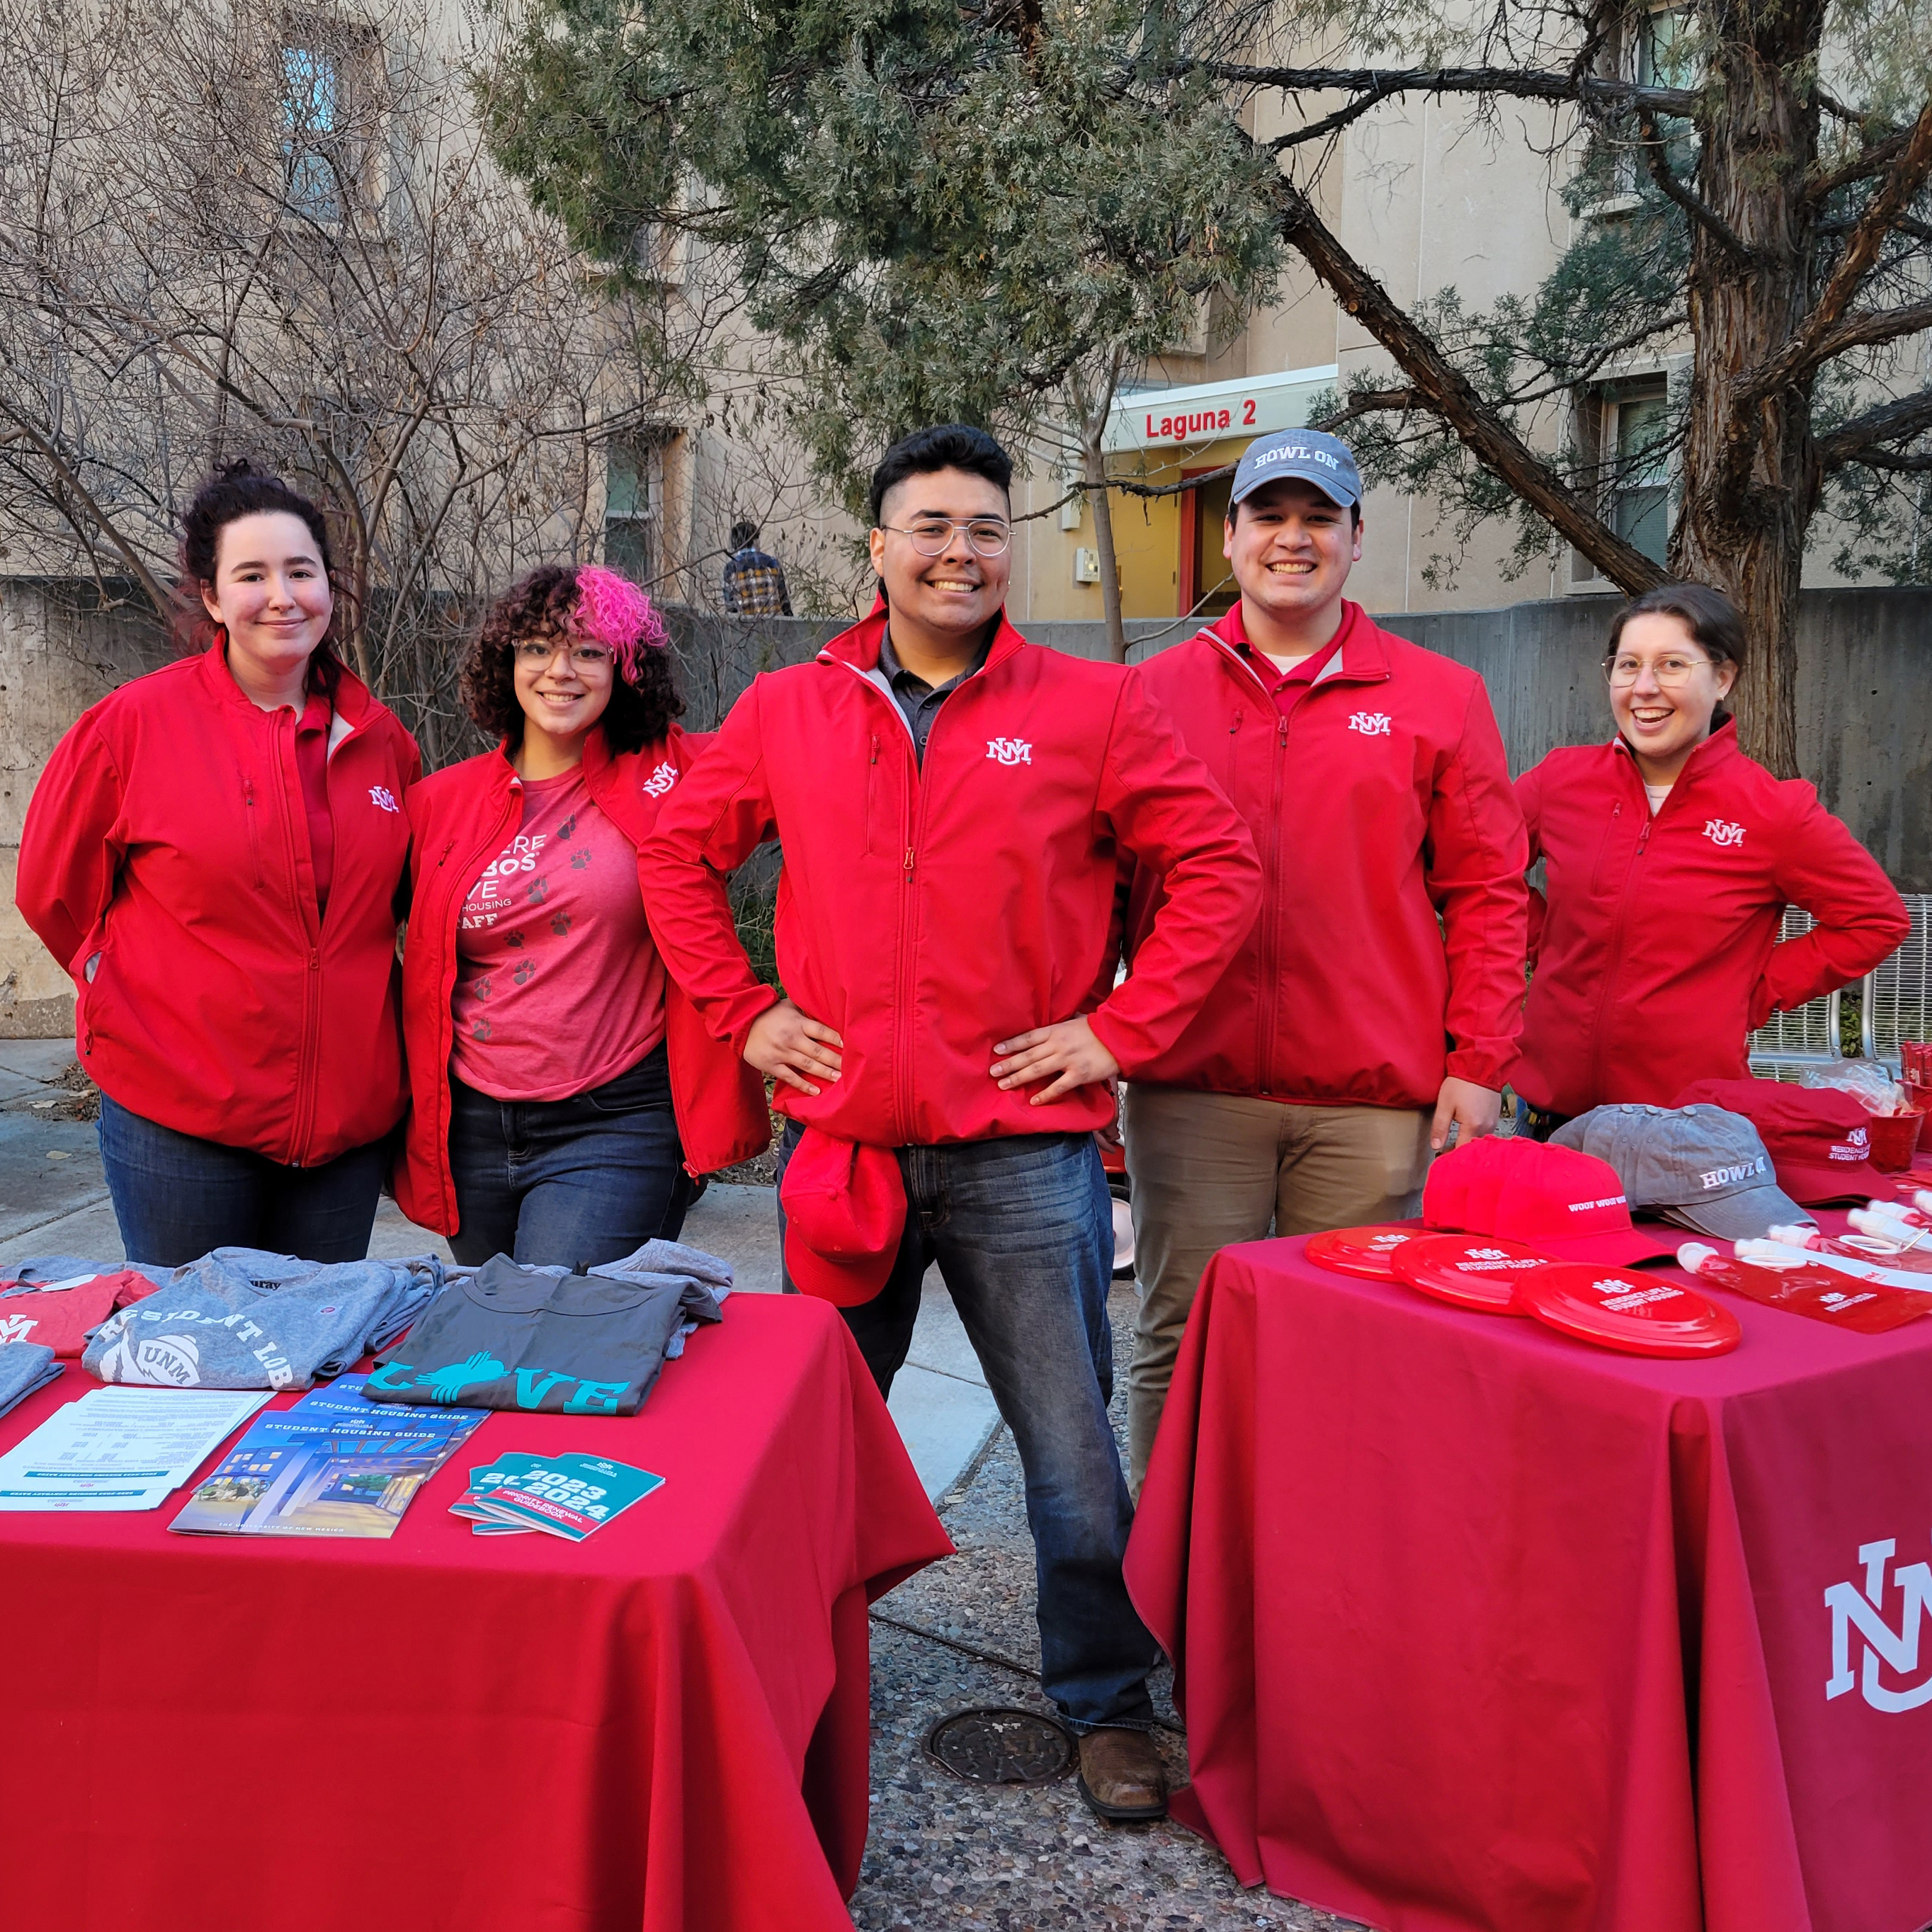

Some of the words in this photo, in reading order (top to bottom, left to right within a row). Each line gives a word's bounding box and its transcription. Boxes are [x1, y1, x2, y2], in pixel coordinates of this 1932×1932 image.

[1146, 407, 1230, 441] Laguna
[1243, 399, 1256, 425] 2
[1254, 447, 1311, 470] HOWL
[1315, 450, 1339, 470] ON
[462, 898, 511, 912] HOUSING
[457, 913, 498, 929] AFF
[1699, 1163, 1754, 1189] HOWL
[1568, 1201, 1594, 1212] WOOF
[144, 1346, 191, 1385] UNM
[309, 1401, 369, 1414] STUDENT
[370, 1409, 427, 1419] HOUSING
[265, 1424, 328, 1433] STUDENT
[330, 1428, 391, 1437] HOUSING
[521, 1470, 607, 1500] 2023
[503, 1490, 543, 1506] PRIORITY
[541, 1502, 583, 1523] RENEWAL
[513, 1496, 566, 1519] GUIDEBOOK
[522, 1482, 610, 1520] 2024
